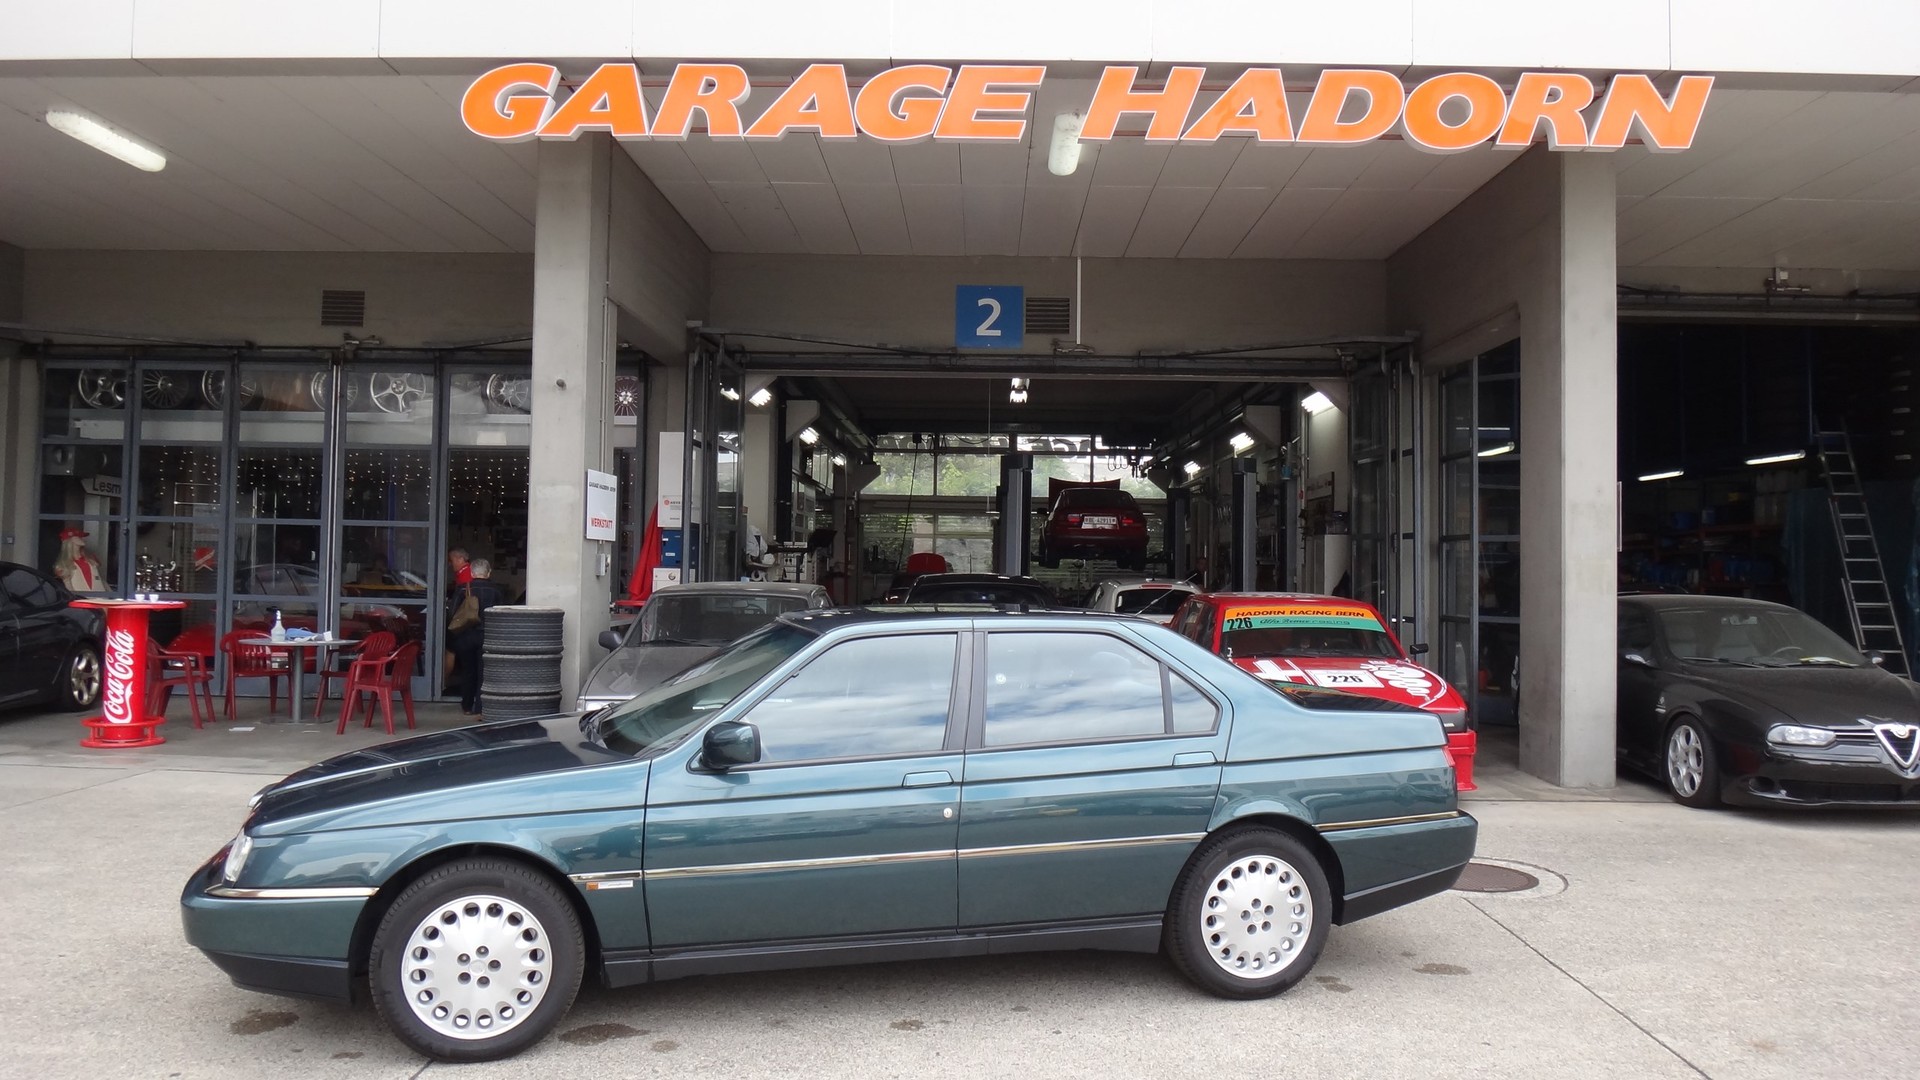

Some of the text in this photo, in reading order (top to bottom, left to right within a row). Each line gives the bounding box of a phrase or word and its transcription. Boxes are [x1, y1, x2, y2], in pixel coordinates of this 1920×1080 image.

[461, 62, 1716, 151] GARAGE HADORN
[976, 297, 1002, 336] 2
[591, 517, 613, 529] WERKSTATT
[1236, 610, 1286, 618] HADORN
[1227, 617, 1253, 631] 226
[103, 625, 135, 724] Coca-Cola
[1327, 674, 1364, 684] 226
